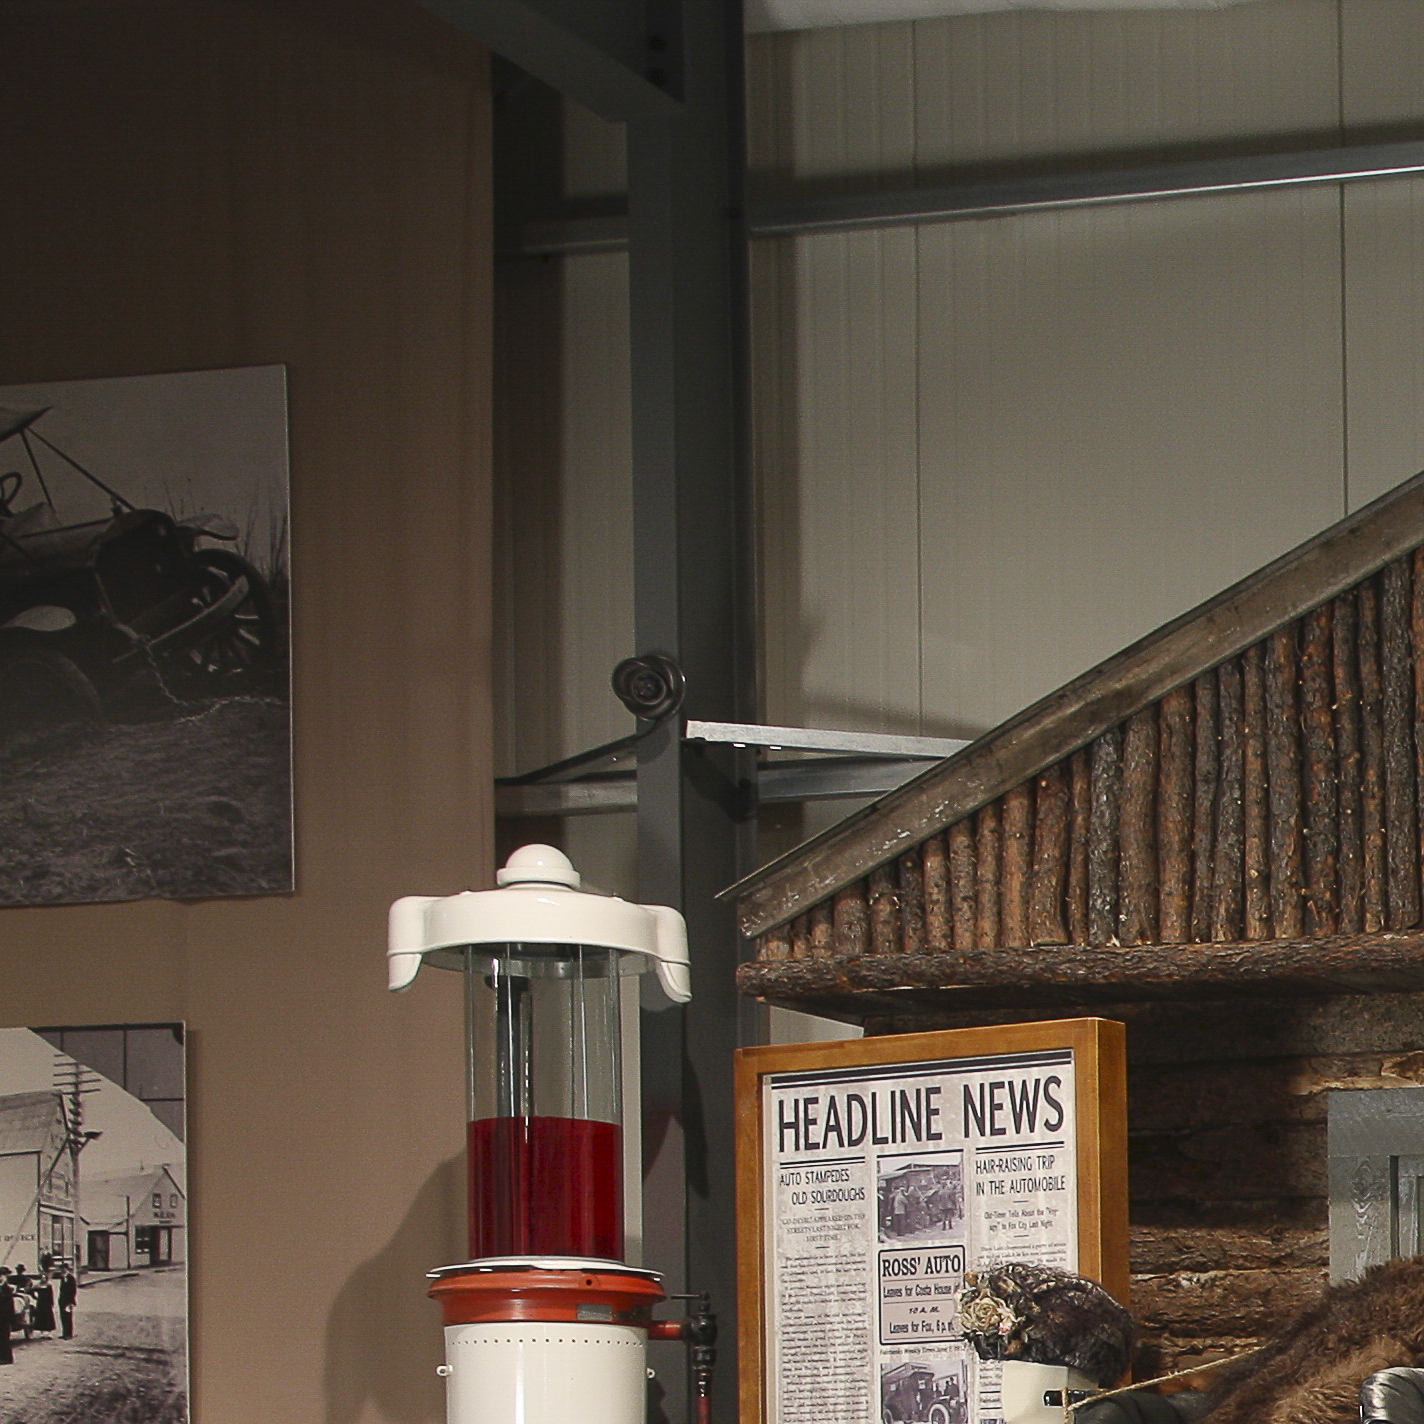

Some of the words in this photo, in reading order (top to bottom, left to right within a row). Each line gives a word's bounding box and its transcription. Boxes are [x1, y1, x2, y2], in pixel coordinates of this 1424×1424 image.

[778, 1086, 943, 1153] HEADLINE
[963, 1075, 1065, 1139] NEWS
[975, 1157, 1032, 1174] HAIR-RAISING
[1036, 1155, 1055, 1170] TRIP
[780, 1172, 801, 1186] AUTO
[805, 1169, 850, 1184] STAMPEDES
[976, 1181, 985, 1196] IN
[988, 1180, 1005, 1195] THE
[1009, 1175, 1066, 1193] AUTOMOBILE
[791, 1191, 808, 1205] OLD
[811, 1187, 866, 1204] SOURDOUGHS
[881, 1256, 921, 1277] ROSS'
[924, 1254, 961, 1275] AUTO
[883, 1286, 903, 1298] Leaves
[905, 1285, 913, 1297] for
[889, 1321, 909, 1334] Leaves
[911, 1320, 920, 1332] for
